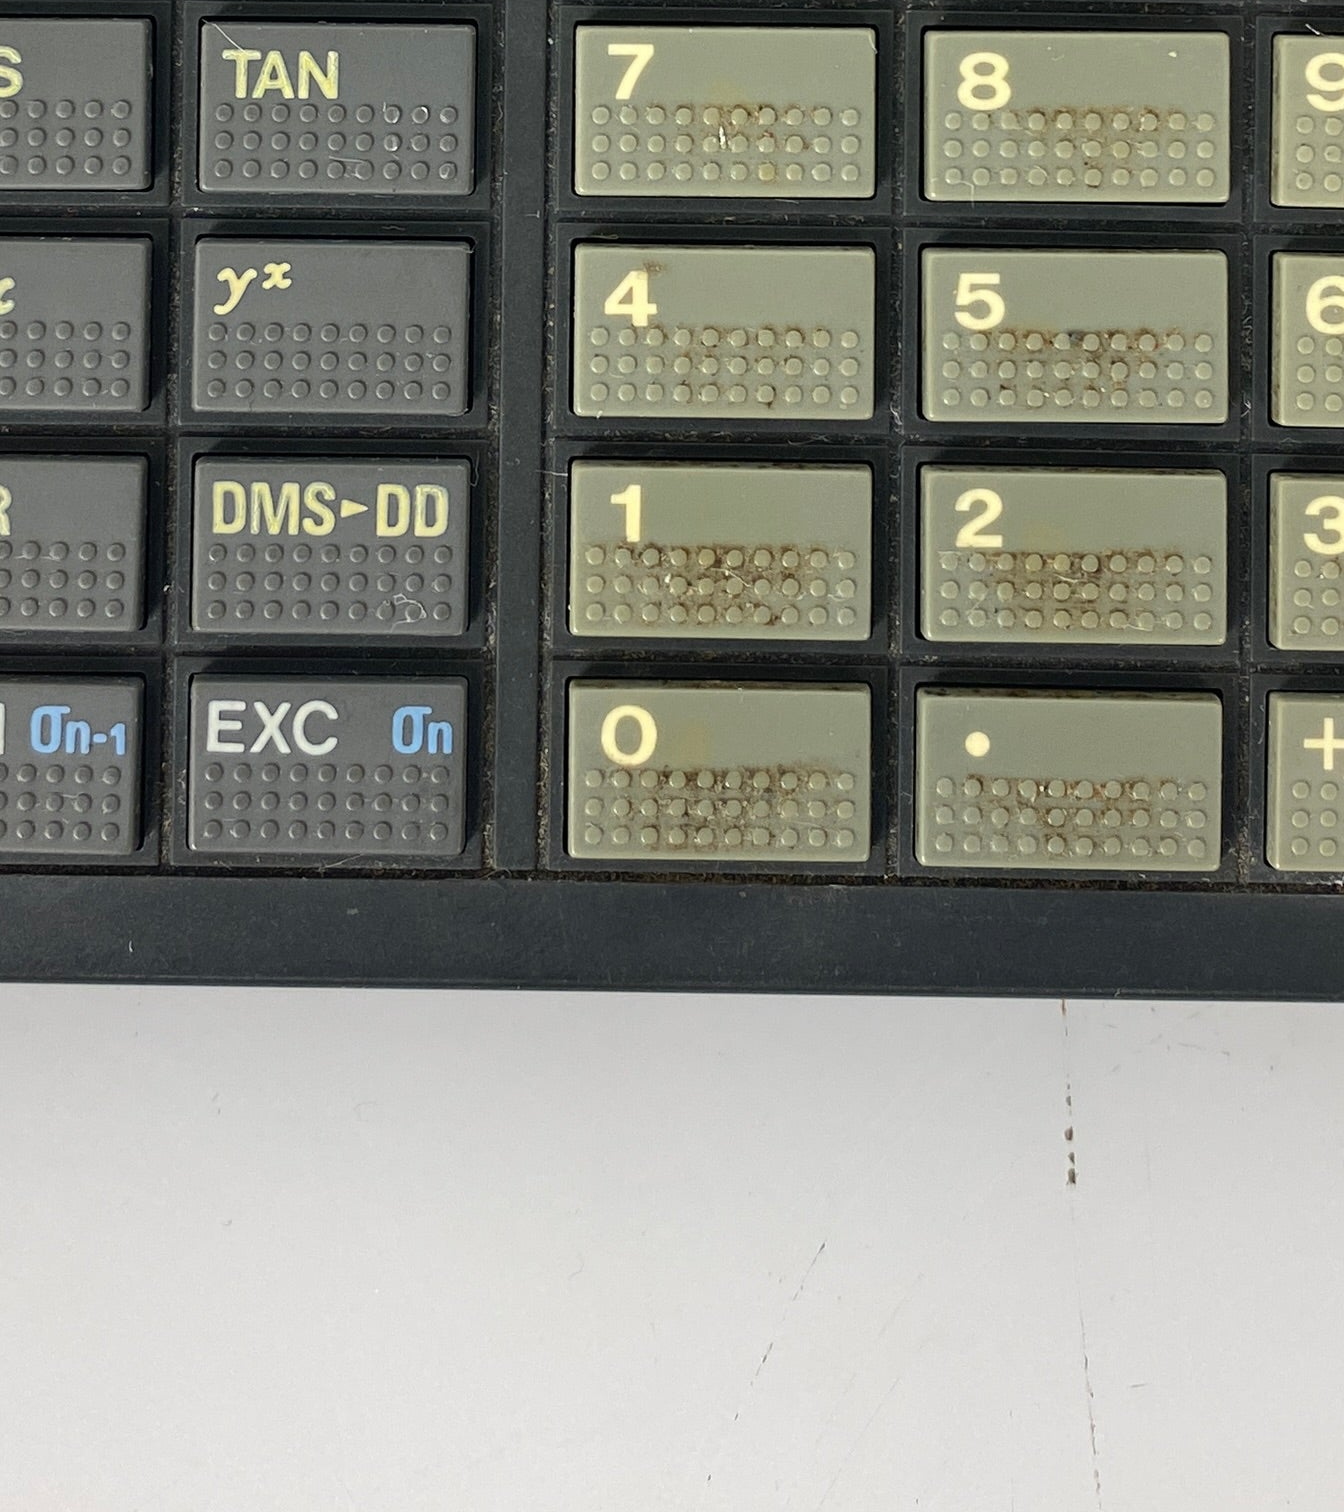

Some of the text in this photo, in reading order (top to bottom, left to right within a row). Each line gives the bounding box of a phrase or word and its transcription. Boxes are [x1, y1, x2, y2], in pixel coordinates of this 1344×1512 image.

[222, 50, 340, 99] TAN
[608, 44, 654, 99] 7
[958, 53, 1011, 110] 8
[605, 271, 657, 326] 4
[955, 273, 1006, 330] 5
[611, 485, 644, 542] 1
[955, 489, 1003, 548] 2
[207, 701, 338, 755] EXC
[601, 705, 658, 764] 0
